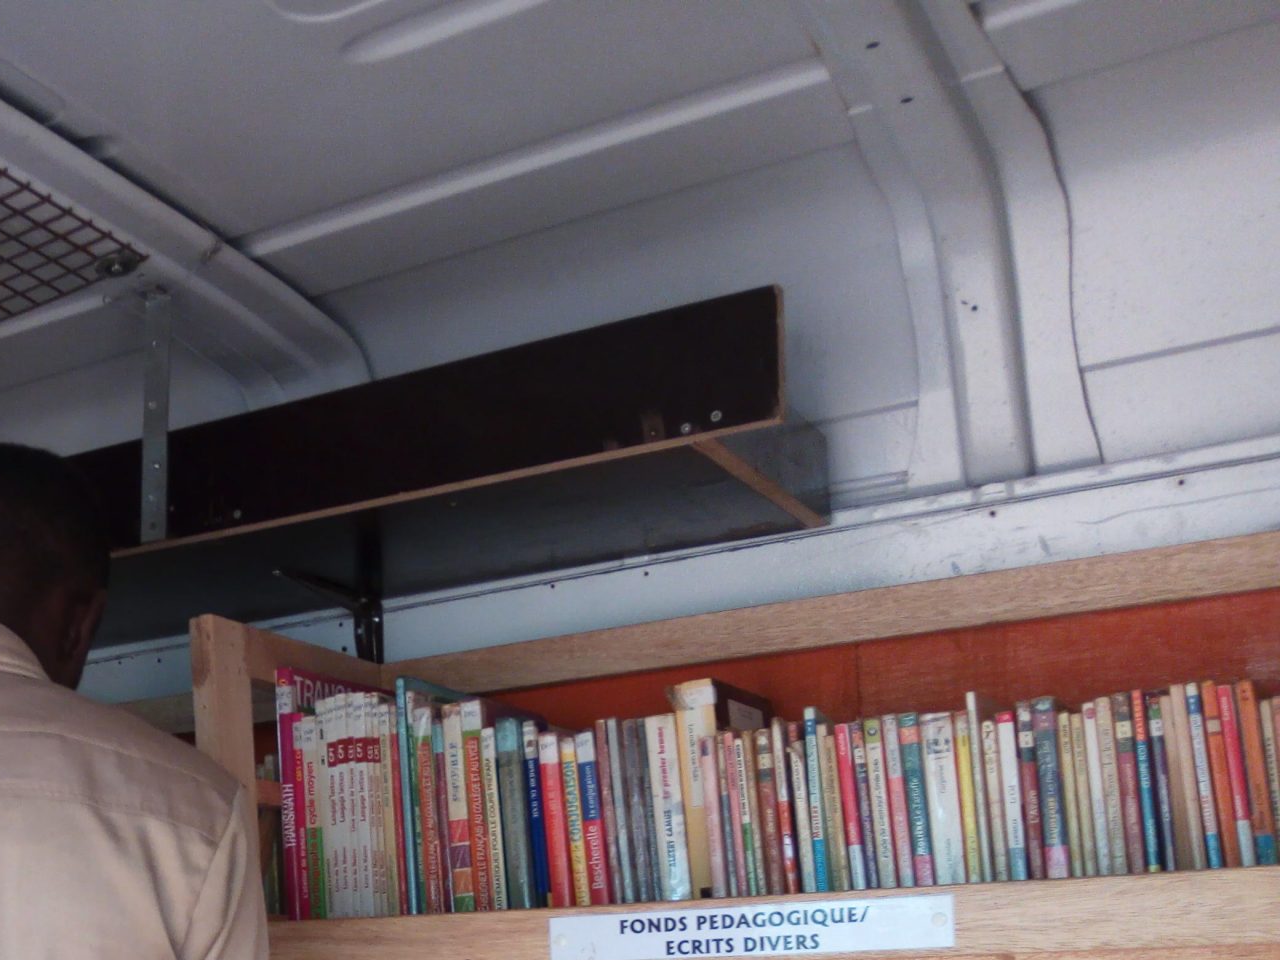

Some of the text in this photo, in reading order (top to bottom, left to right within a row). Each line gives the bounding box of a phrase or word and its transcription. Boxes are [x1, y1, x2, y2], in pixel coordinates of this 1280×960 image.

[656, 727, 666, 755] homme
[304, 762, 316, 796] moyen
[470, 762, 479, 772] AU
[470, 773, 479, 781] ET
[658, 756, 671, 789] premier
[563, 761, 581, 843] CONJUGAISON
[911, 776, 923, 808] Tartuffe
[1007, 785, 1016, 796] Cid
[282, 783, 297, 849] TRANSMATH
[307, 798, 318, 826] cycle
[473, 814, 483, 824] AU
[487, 792, 496, 818] COURS
[1028, 789, 1040, 824] L'Avare
[584, 765, 604, 889] Bescherelle la conjugaison
[663, 809, 675, 837] CAMUS
[474, 826, 488, 860] FRANÇAIS
[491, 829, 499, 851] POUR
[665, 838, 677, 868] ALBERT
[477, 861, 485, 870] LE
[477, 870, 489, 912] ENSEIGNER
[619, 906, 869, 935] FONDS PEDAGOGIQUE/
[665, 934, 820, 956] ECRITS DIVERS
